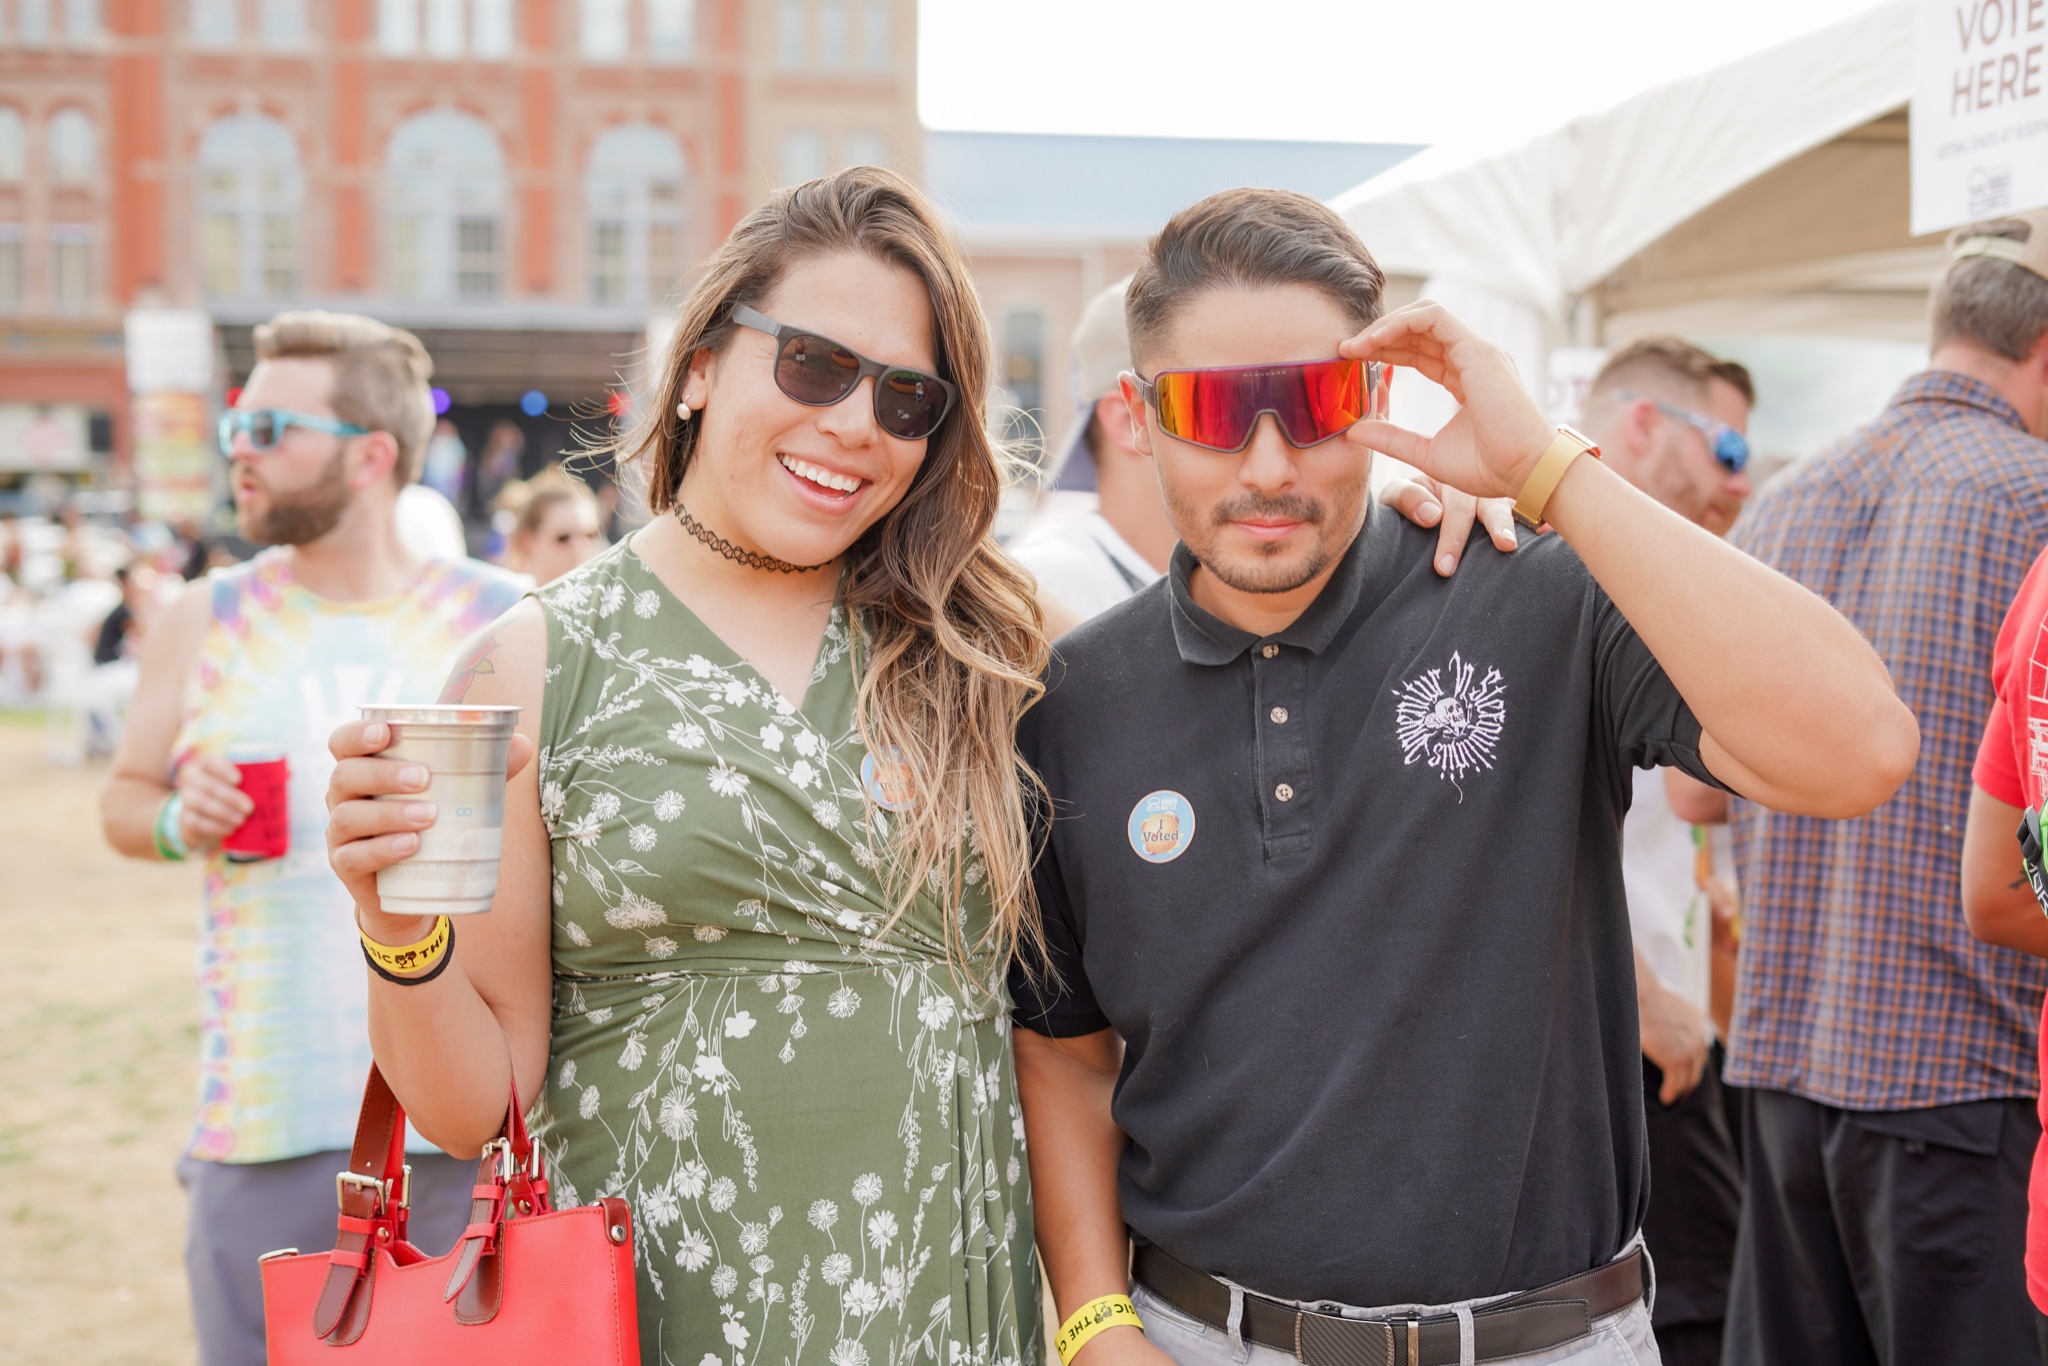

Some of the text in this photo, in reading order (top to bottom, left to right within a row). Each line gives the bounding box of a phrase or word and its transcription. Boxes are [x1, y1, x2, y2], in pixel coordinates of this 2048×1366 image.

[1951, 44, 2043, 117] HERE
[1143, 829, 1179, 842] Voted
[1159, 819, 1164, 829] I
[419, 931, 444, 959] THE
[1068, 1316, 1092, 1341] THE
